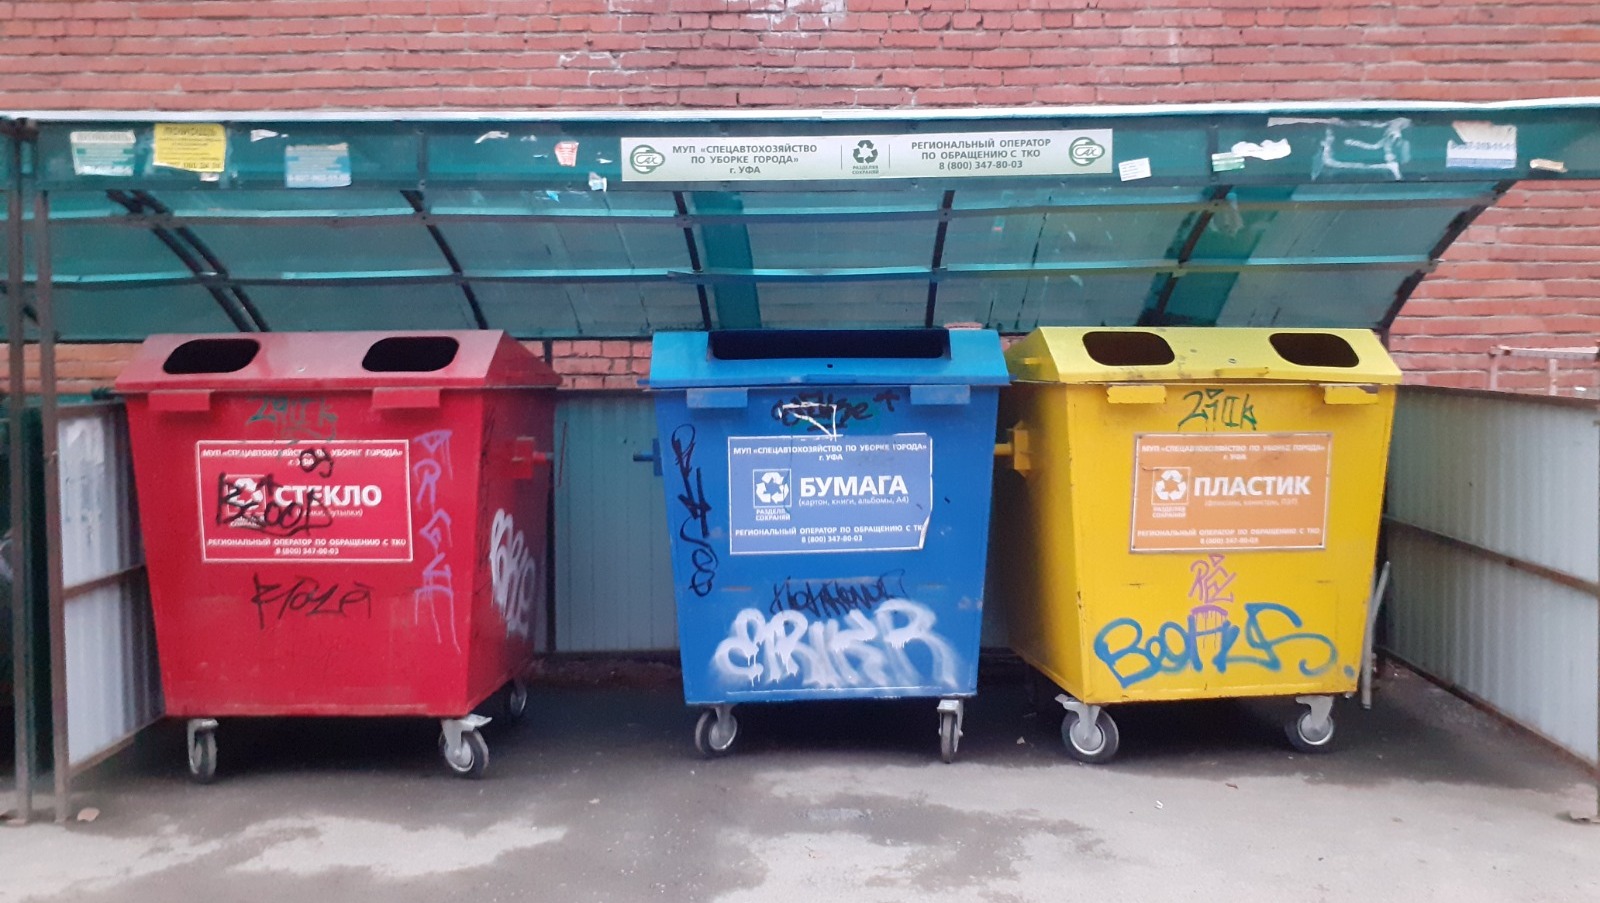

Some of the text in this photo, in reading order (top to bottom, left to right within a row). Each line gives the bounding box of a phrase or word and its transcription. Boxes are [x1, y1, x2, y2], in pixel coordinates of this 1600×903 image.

[672, 143, 818, 155] МУП «СПЕЦАВТОХОЗЯЙСТВО
[911, 138, 1051, 150] РЕГИОНАЛЬНЫЙ ОПЕРАТОР
[691, 155, 799, 165] ПО УБОРКЕ ГОРОДА»
[921, 149, 1041, 160] ПО ОБРАЩЕНИЮ С ТКО
[738, 166, 761, 174] УФА
[938, 160, 1023, 171] 8 (800) 347-80-03
[202, 448, 222, 457] МУП
[733, 447, 752, 455] МУП
[753, 442, 843, 455] «СПЕЦАВТОХОЗЯЙСТВО
[845, 444, 857, 452] ПО
[859, 444, 890, 452] УБОРКЕ
[825, 453, 844, 461] УФА
[800, 475, 909, 497] БУМАГА
[1193, 476, 1312, 497] ПЛАСТИК
[275, 484, 383, 507] СТЕКЛО
[735, 526, 797, 536] РЕГИОНАЛЬНЫЙ
[799, 526, 837, 535] ОПЕРАТОР
[839, 526, 851, 534] ПО
[853, 525, 903, 534] ОБРАЩЕНИЮ
[273, 538, 312, 546] ОПЕРАТОР
[315, 538, 327, 546] ПО
